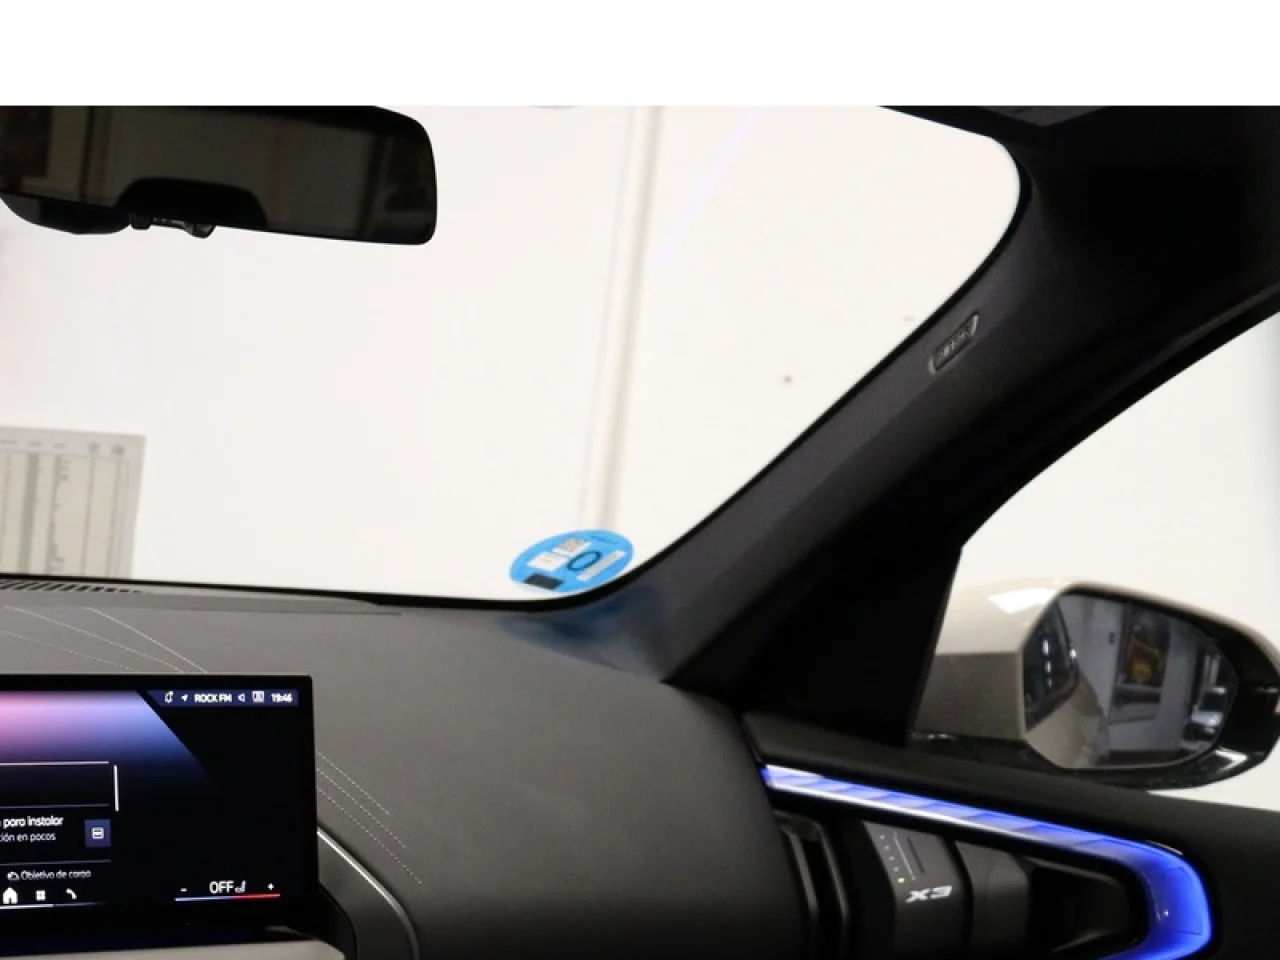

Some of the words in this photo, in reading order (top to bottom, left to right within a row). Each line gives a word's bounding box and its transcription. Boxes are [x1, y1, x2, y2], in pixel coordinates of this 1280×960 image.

[194, 692, 218, 703] ROCK
[3, 817, 26, 829] para
[17, 833, 28, 843] en
[30, 832, 56, 843] pocos
[56, 870, 67, 879] de
[209, 880, 235, 894] OFF
[904, 885, 953, 904] X3
